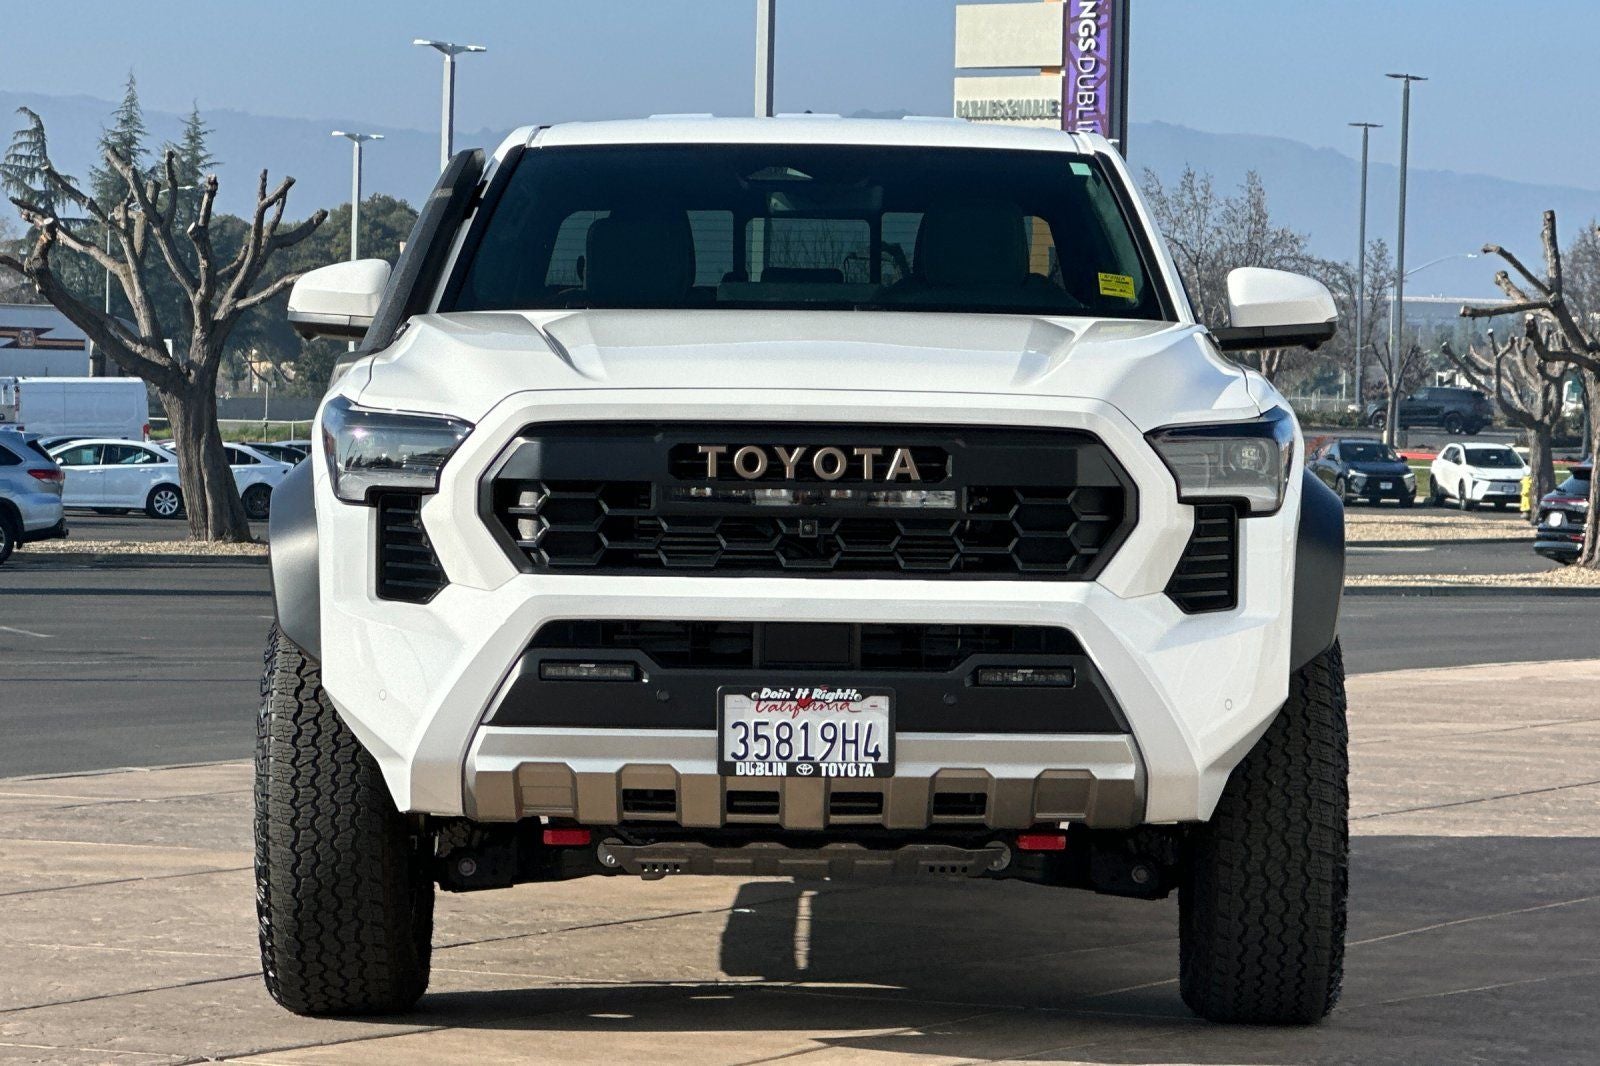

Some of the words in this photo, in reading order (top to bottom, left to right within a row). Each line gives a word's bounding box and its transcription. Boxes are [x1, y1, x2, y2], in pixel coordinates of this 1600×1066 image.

[698, 445, 921, 481] TOYOTA
[760, 687, 794, 700] Doin'
[795, 688, 810, 700] It
[811, 688, 855, 703] Right!
[731, 721, 882, 761] 35819H4
[735, 762, 787, 776] DUBLIN
[819, 763, 874, 777] TOYOTA
